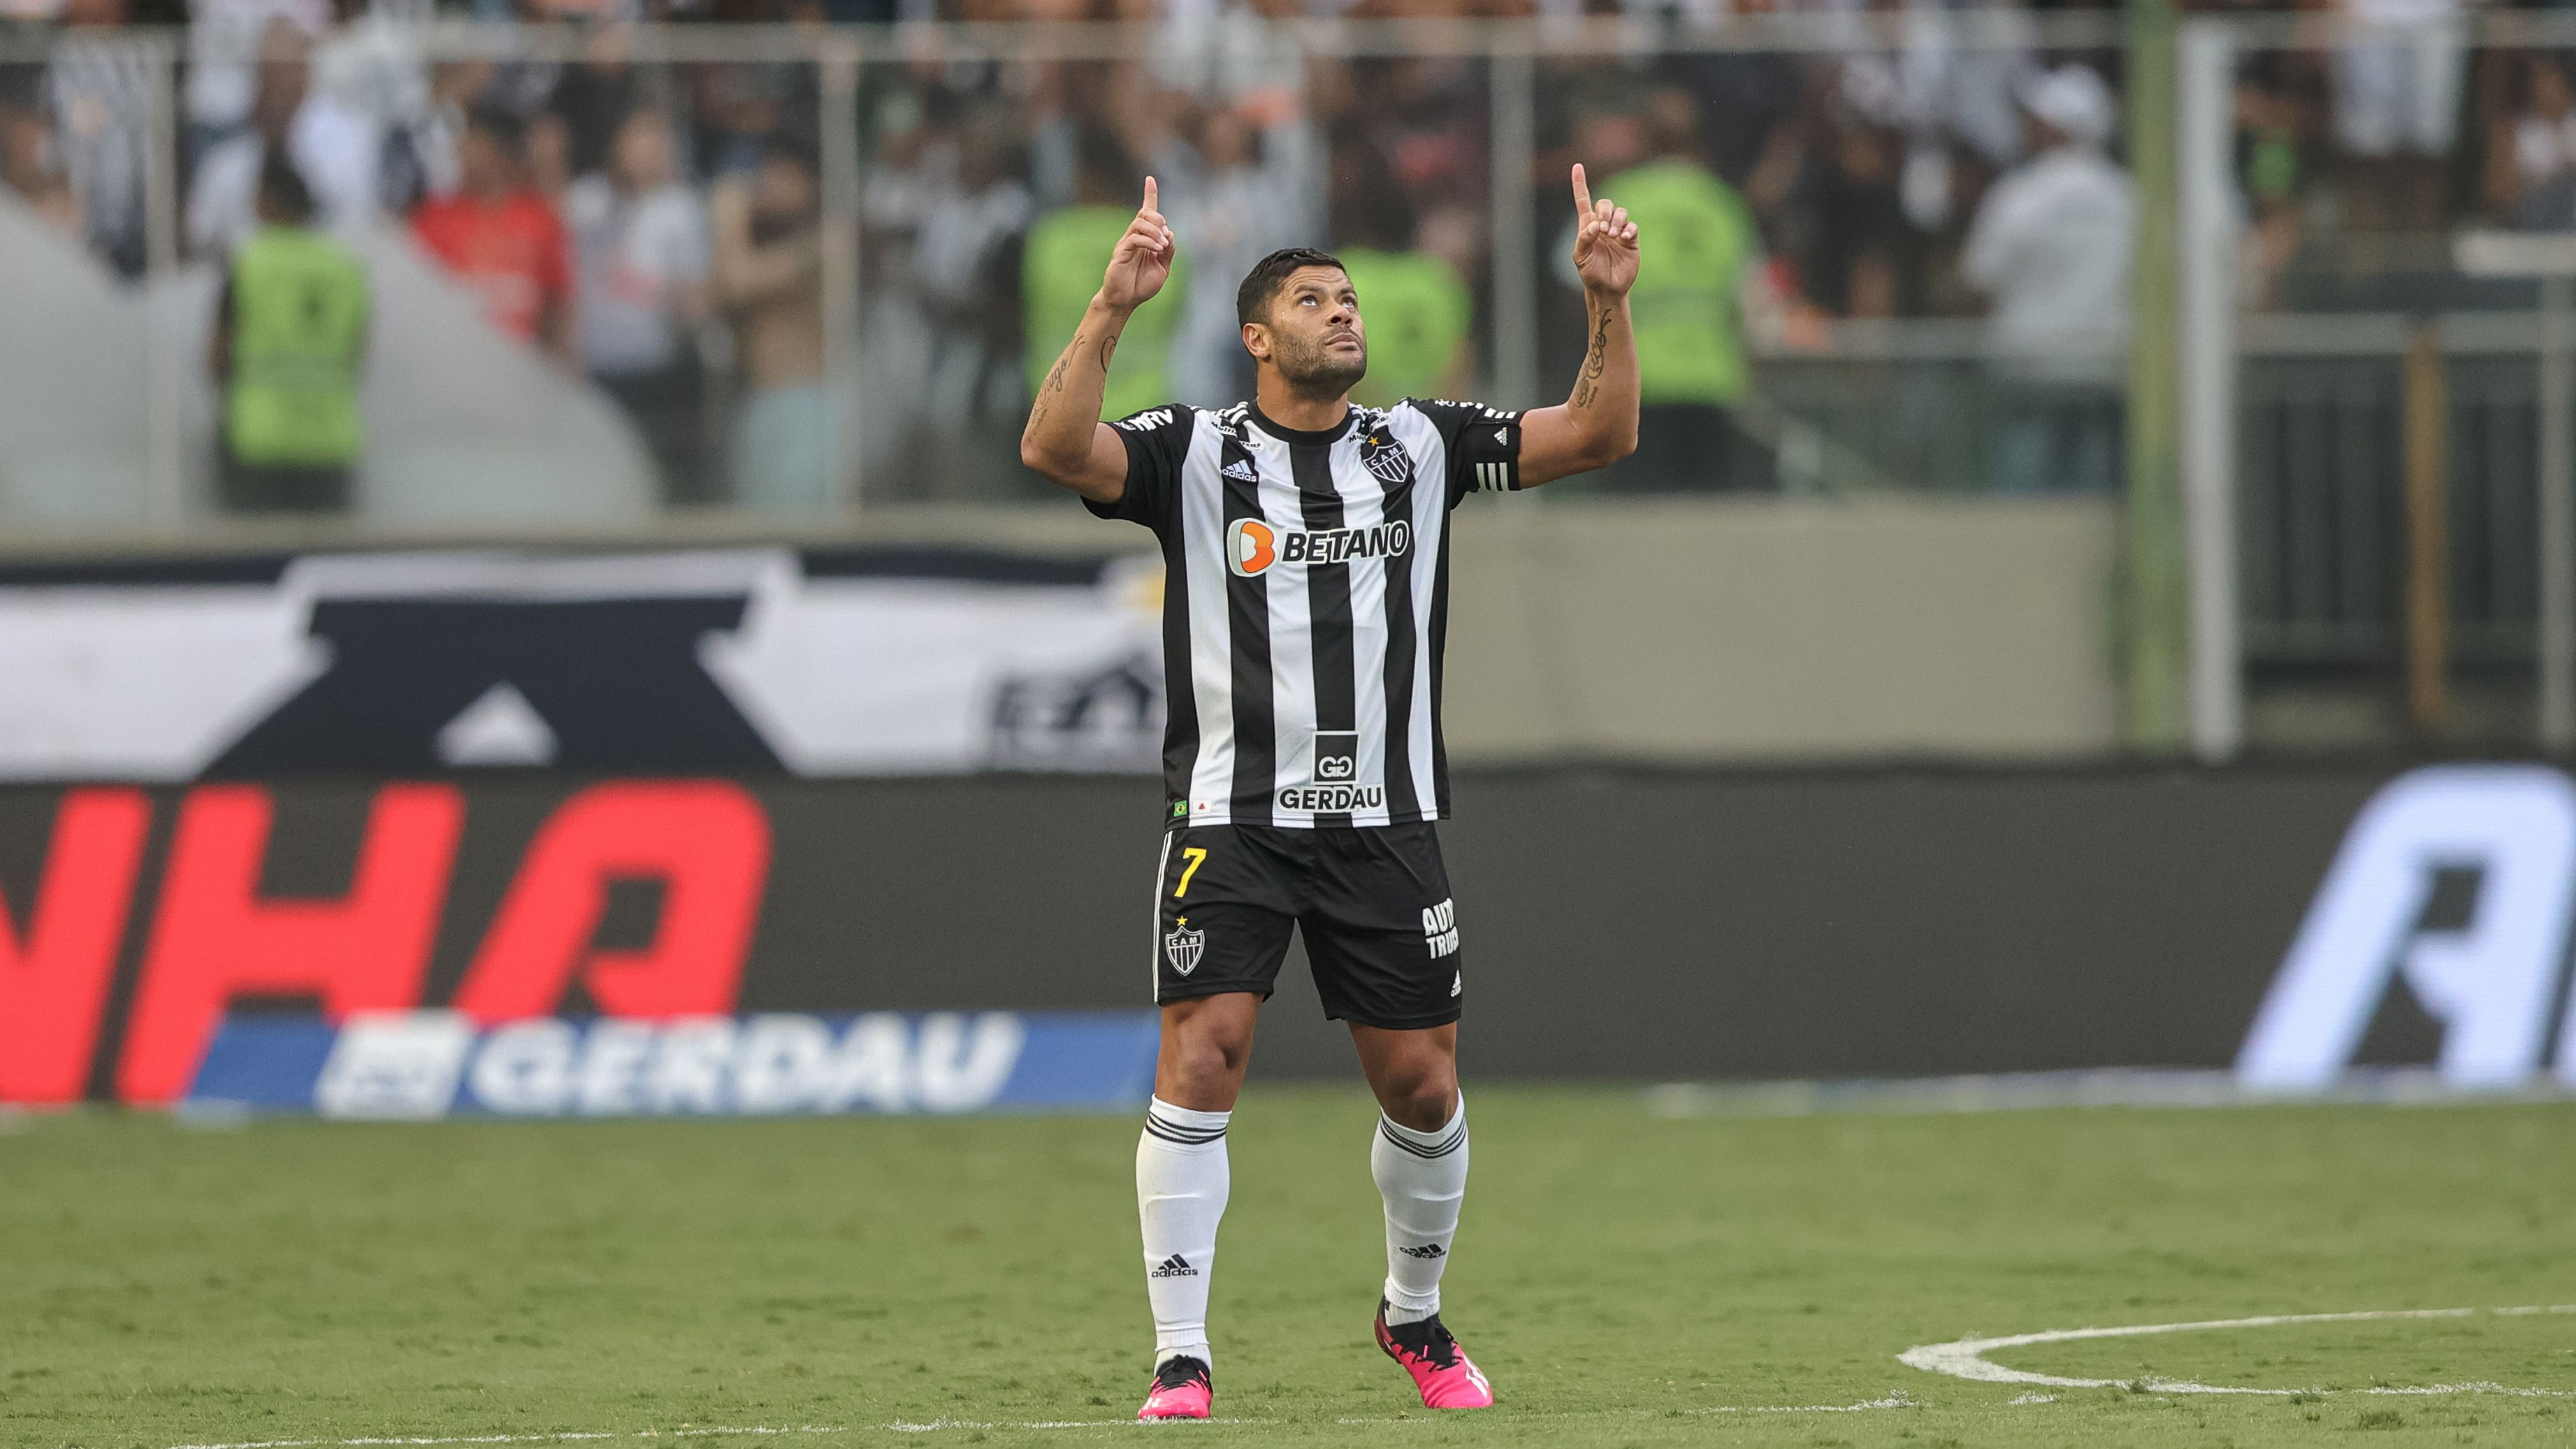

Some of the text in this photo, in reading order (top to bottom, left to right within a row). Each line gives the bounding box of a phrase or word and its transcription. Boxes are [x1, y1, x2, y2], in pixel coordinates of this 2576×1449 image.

[1370, 447, 1398, 466] CAM
[1222, 468, 1257, 482] adidas
[1282, 521, 1408, 562] BETANO
[1280, 786, 1382, 809] GERDAU
[1173, 847, 1208, 898] 7
[1171, 936, 1198, 946] CAM
[467, 1015, 1024, 1115] GERDAU
[1152, 1267, 1199, 1278] adidas
